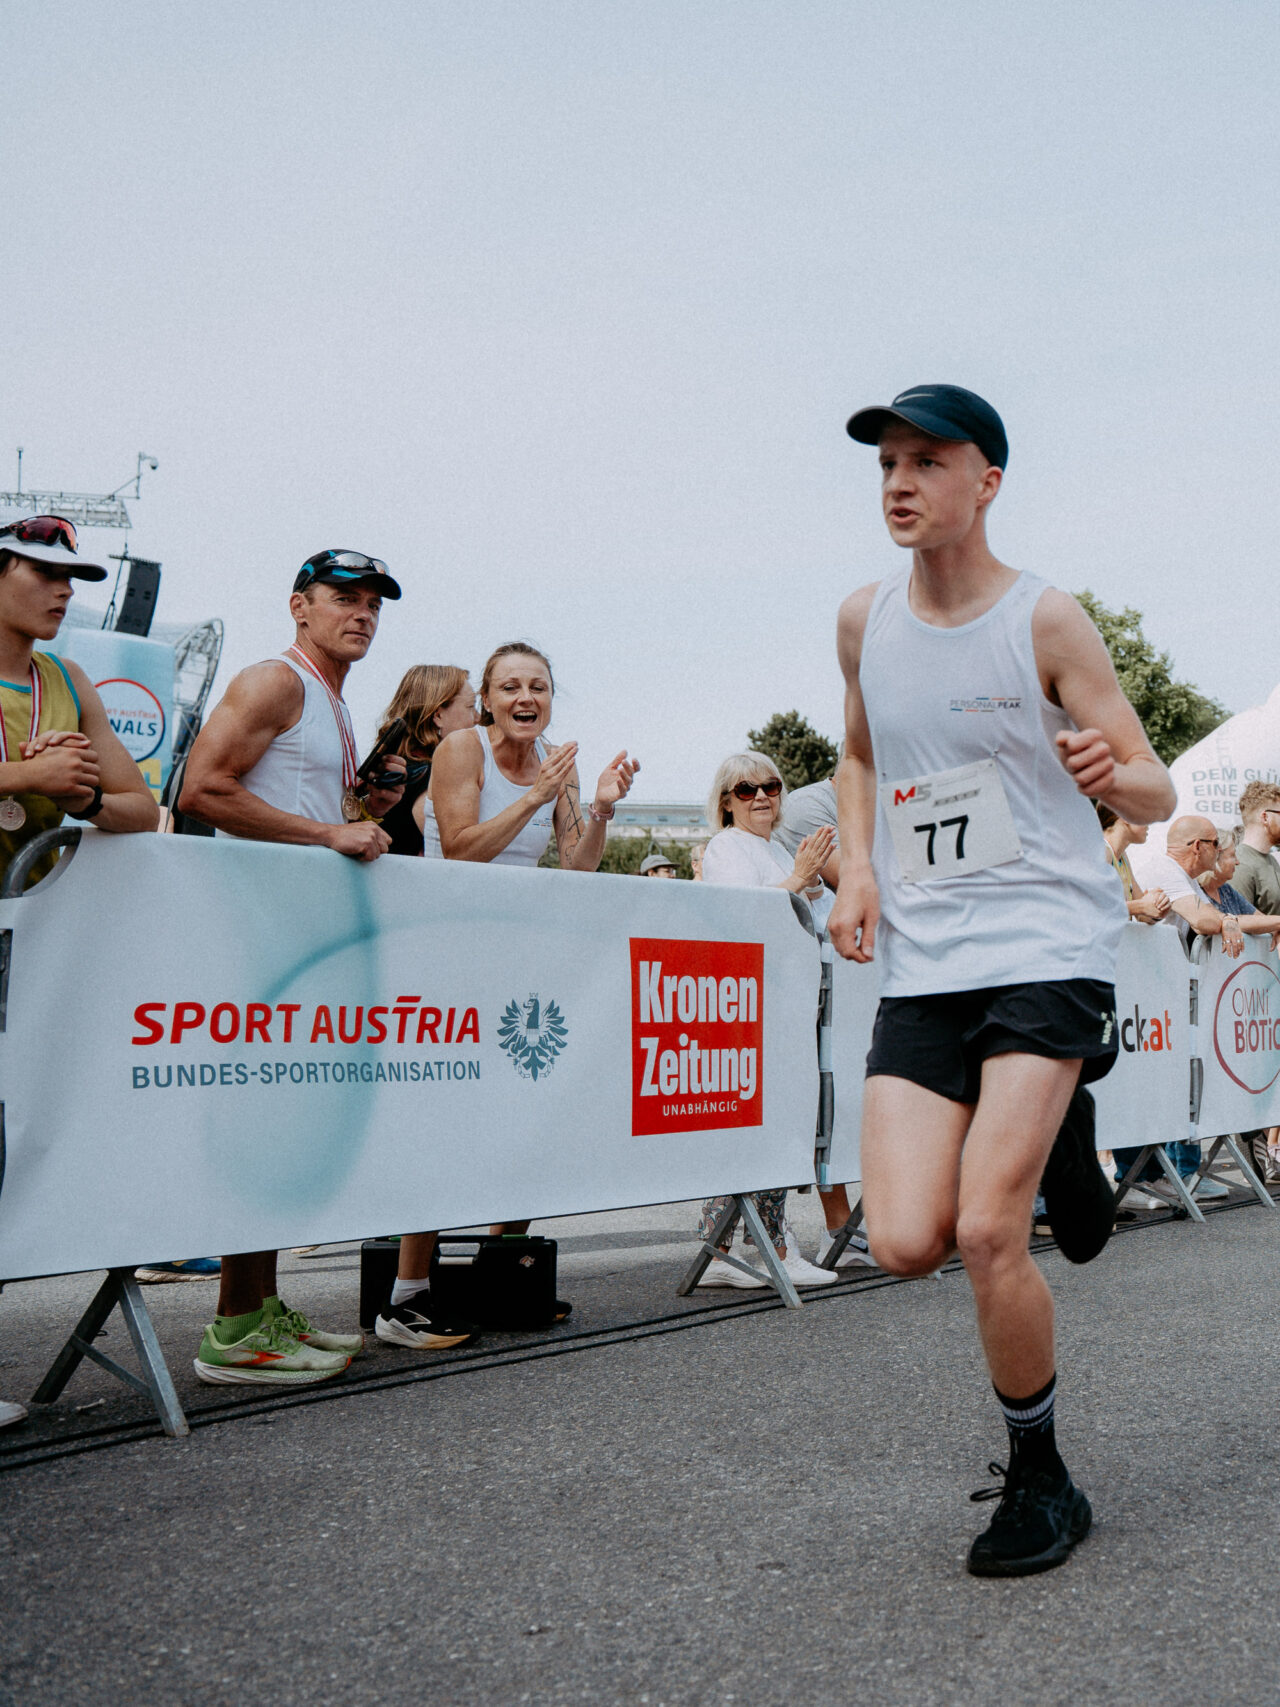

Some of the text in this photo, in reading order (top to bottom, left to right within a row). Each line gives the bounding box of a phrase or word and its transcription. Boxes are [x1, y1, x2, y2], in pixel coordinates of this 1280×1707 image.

[109, 718, 158, 737] NALS
[1192, 767, 1237, 782] DEM
[1194, 784, 1238, 797] EINE
[1195, 800, 1240, 815] GEBE
[914, 814, 969, 866] 77
[639, 960, 758, 1024] Kronen
[131, 996, 480, 1045] SPORT AUSTRIA
[1121, 1003, 1172, 1053] ck.at
[132, 1061, 481, 1089] BUNDES-SPORTORGANISATION
[640, 1033, 757, 1100] Zeitung
[663, 1100, 738, 1117] UNABHÄNGIG
